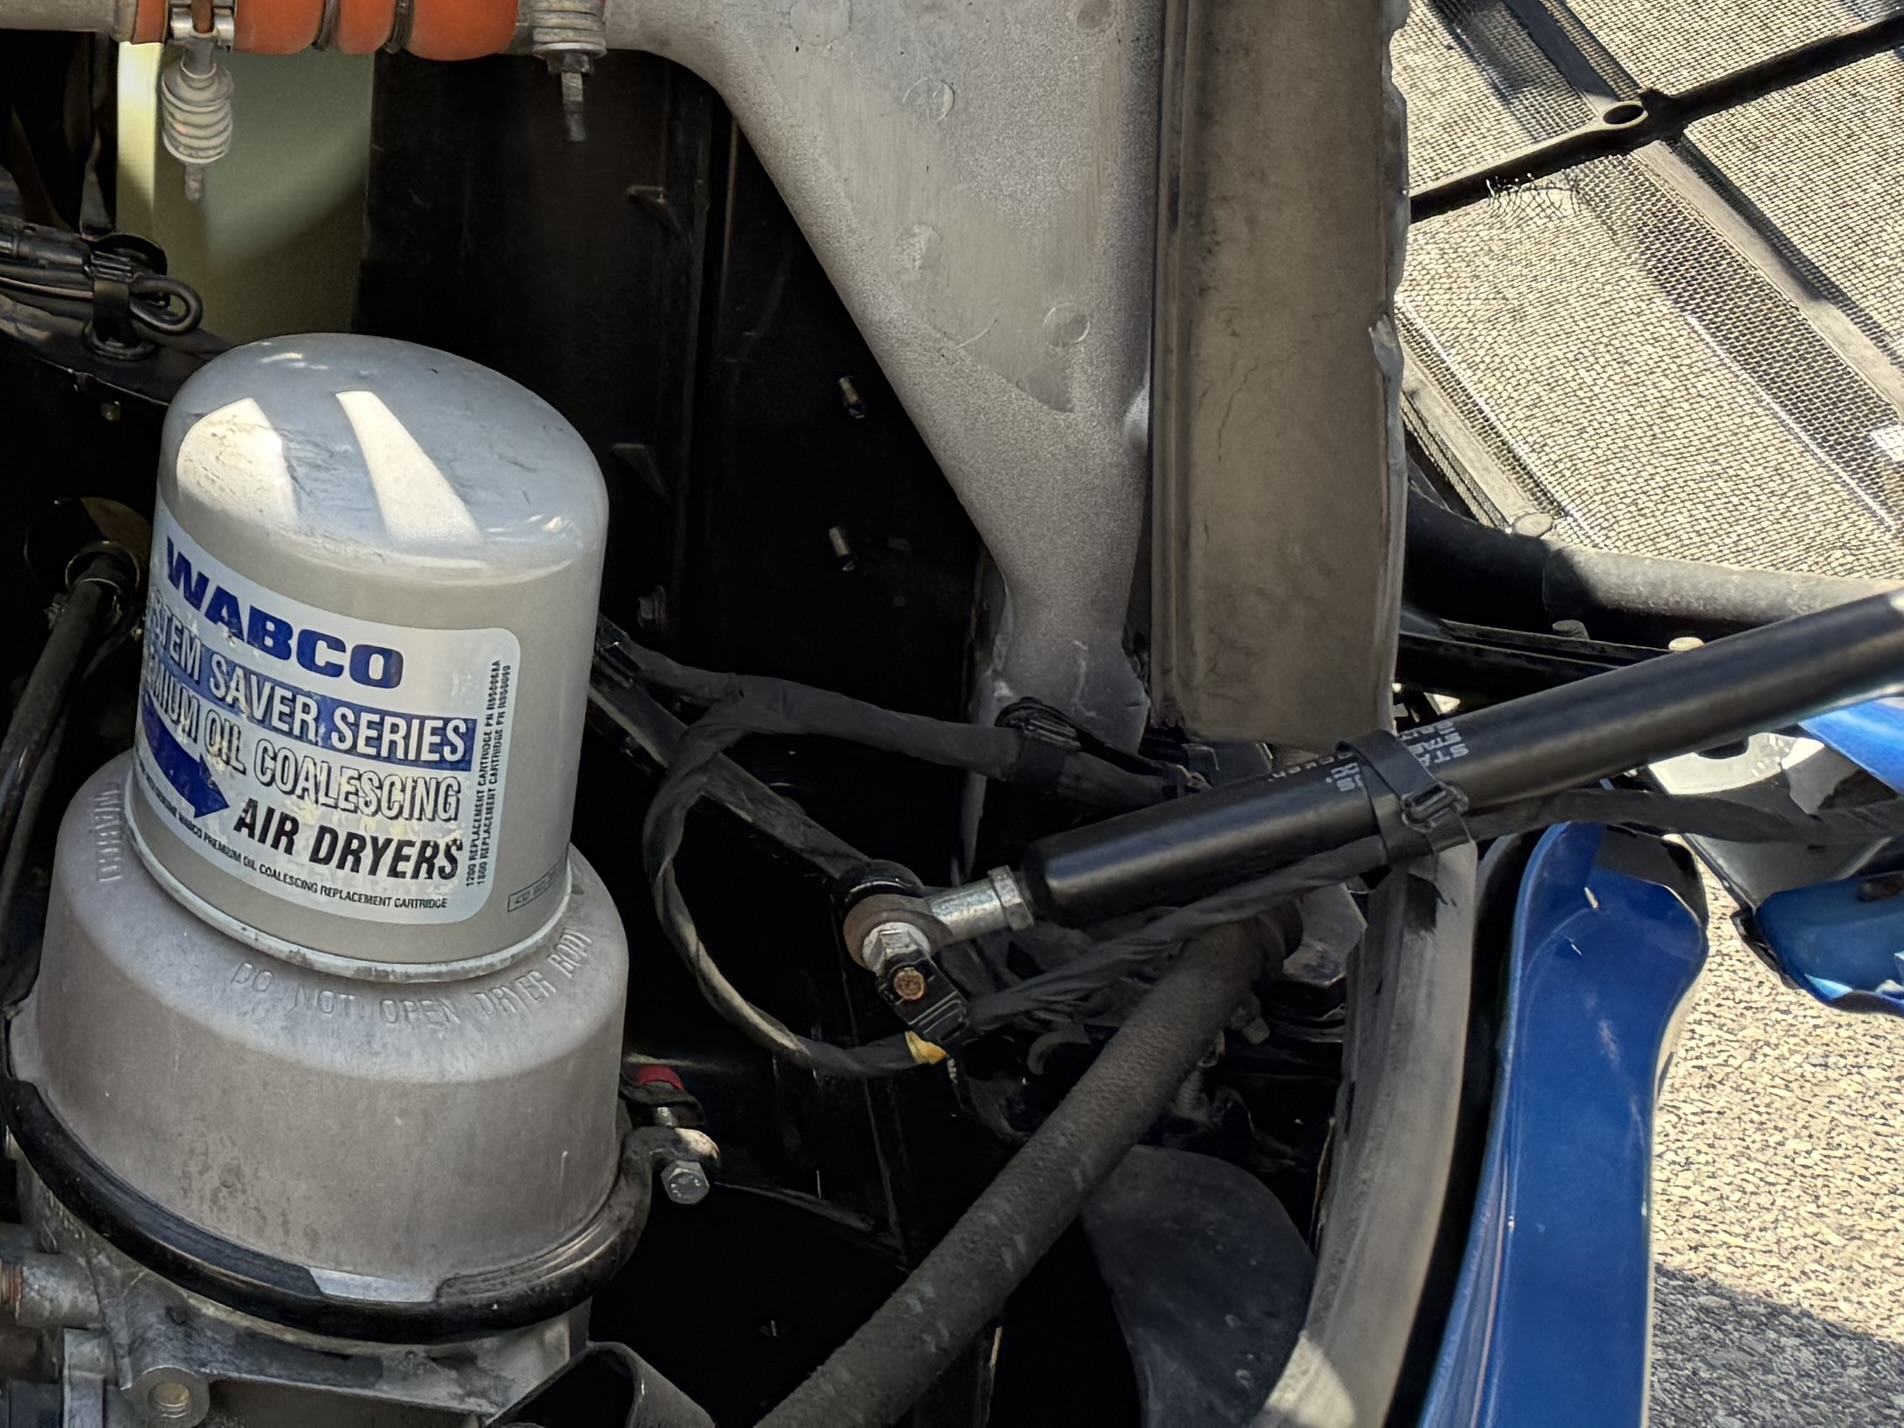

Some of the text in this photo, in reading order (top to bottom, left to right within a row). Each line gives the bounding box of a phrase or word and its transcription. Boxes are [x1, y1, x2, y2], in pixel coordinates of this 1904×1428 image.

[166, 535, 404, 690] WABCO
[209, 653, 318, 744] SAVER
[330, 708, 468, 763] SERIES
[204, 709, 247, 776] OIL
[254, 738, 462, 822] COALESCING
[469, 790, 486, 861] REPLACEMENT
[478, 728, 493, 787] CARTRIDGE
[480, 788, 496, 859] REPLACEMENT
[489, 727, 504, 785] CARTRIDGE
[178, 810, 203, 839] WABCO
[203, 831, 242, 862] PREMIUM
[243, 855, 257, 871] OIL
[259, 863, 318, 894] COALESCING
[320, 884, 393, 907] REPLACEMENT
[394, 898, 448, 909] CARTRIDGE
[233, 797, 463, 880] AIR DRYERS
[230, 929, 593, 1026] DO NOT OPEN DRYER BODY
